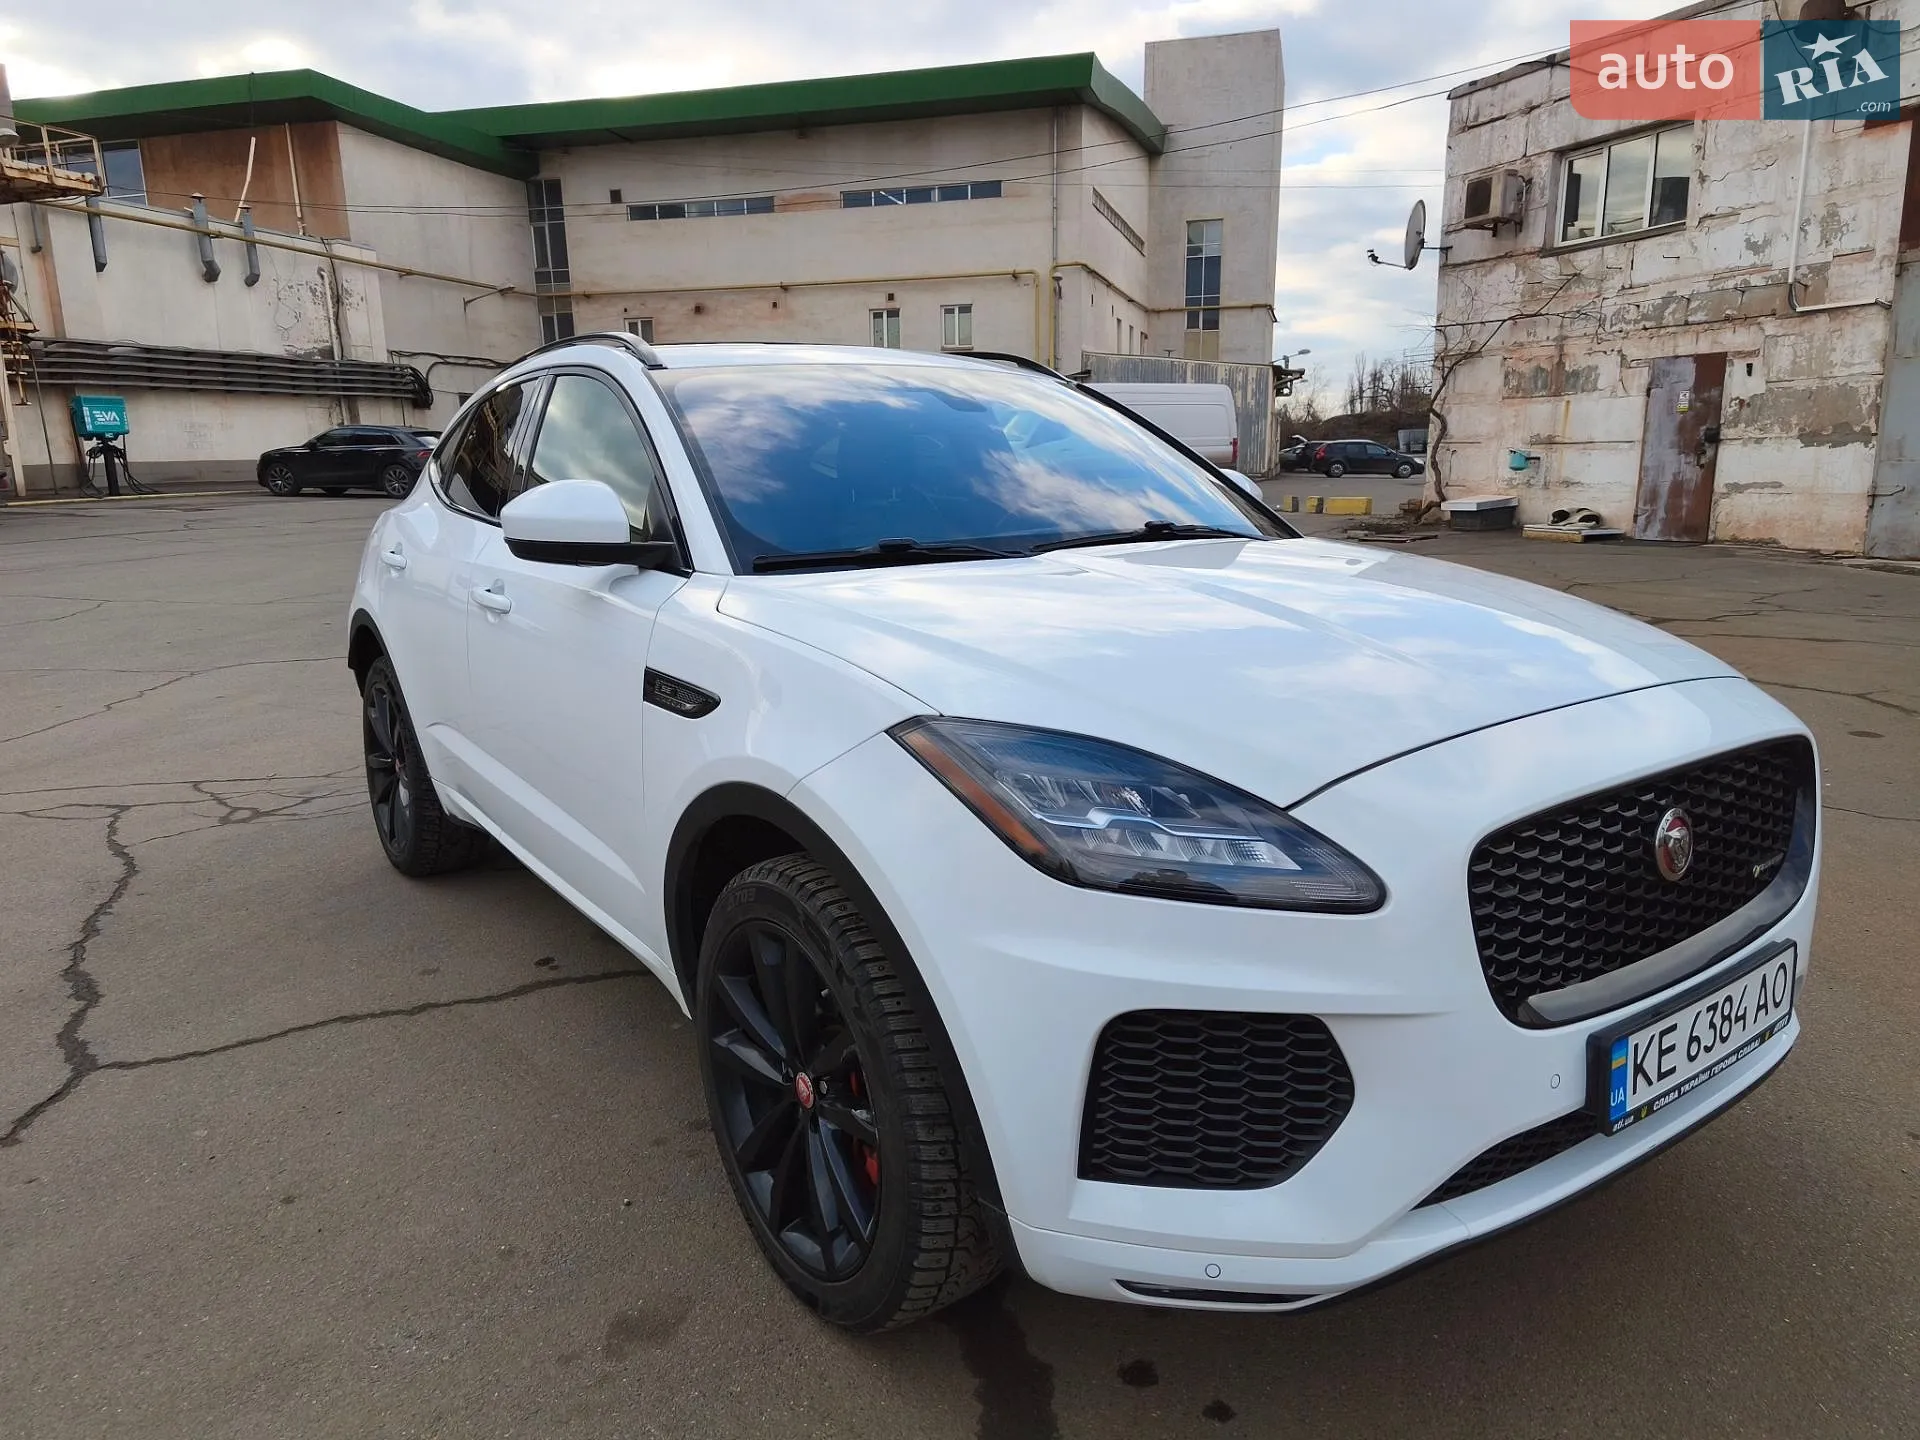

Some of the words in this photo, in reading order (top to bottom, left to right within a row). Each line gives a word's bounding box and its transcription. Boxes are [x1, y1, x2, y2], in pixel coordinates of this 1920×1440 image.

[92, 410, 120, 421] EVA
[1632, 1022, 1679, 1096] KE
[1686, 984, 1748, 1062] 6384
[1753, 962, 1788, 1025] AO
[1610, 1086, 1625, 1107] UA
[1653, 1089, 1679, 1110] СЛАВА
